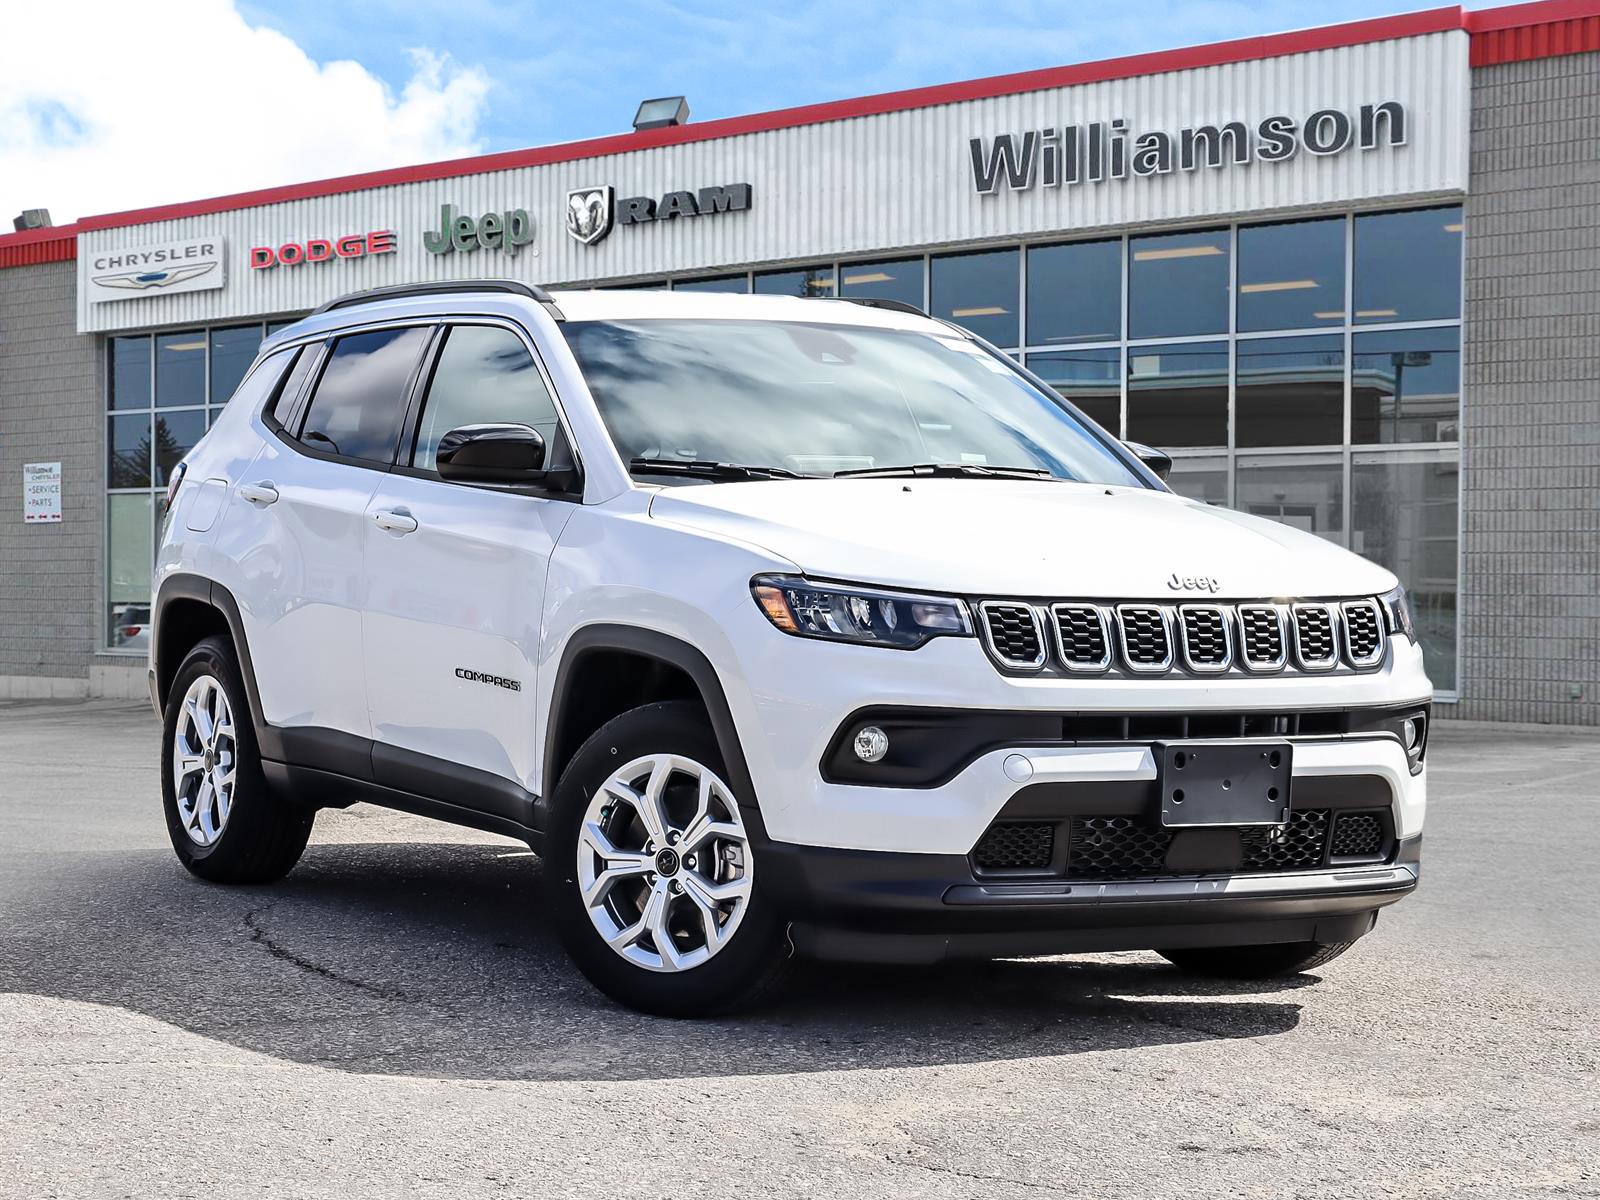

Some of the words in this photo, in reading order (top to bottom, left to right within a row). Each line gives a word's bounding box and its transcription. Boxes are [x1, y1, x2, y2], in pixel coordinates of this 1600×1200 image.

[968, 99, 1407, 194] Williamson
[617, 183, 752, 226] RAM
[423, 203, 533, 257] Jeep
[94, 243, 215, 270] CHRYSLER
[250, 229, 397, 269] DODGE
[32, 484, 60, 494] SERVICE
[32, 498, 52, 507] PARTS
[1166, 572, 1221, 594] Jeep
[454, 667, 522, 693] COMPASS
